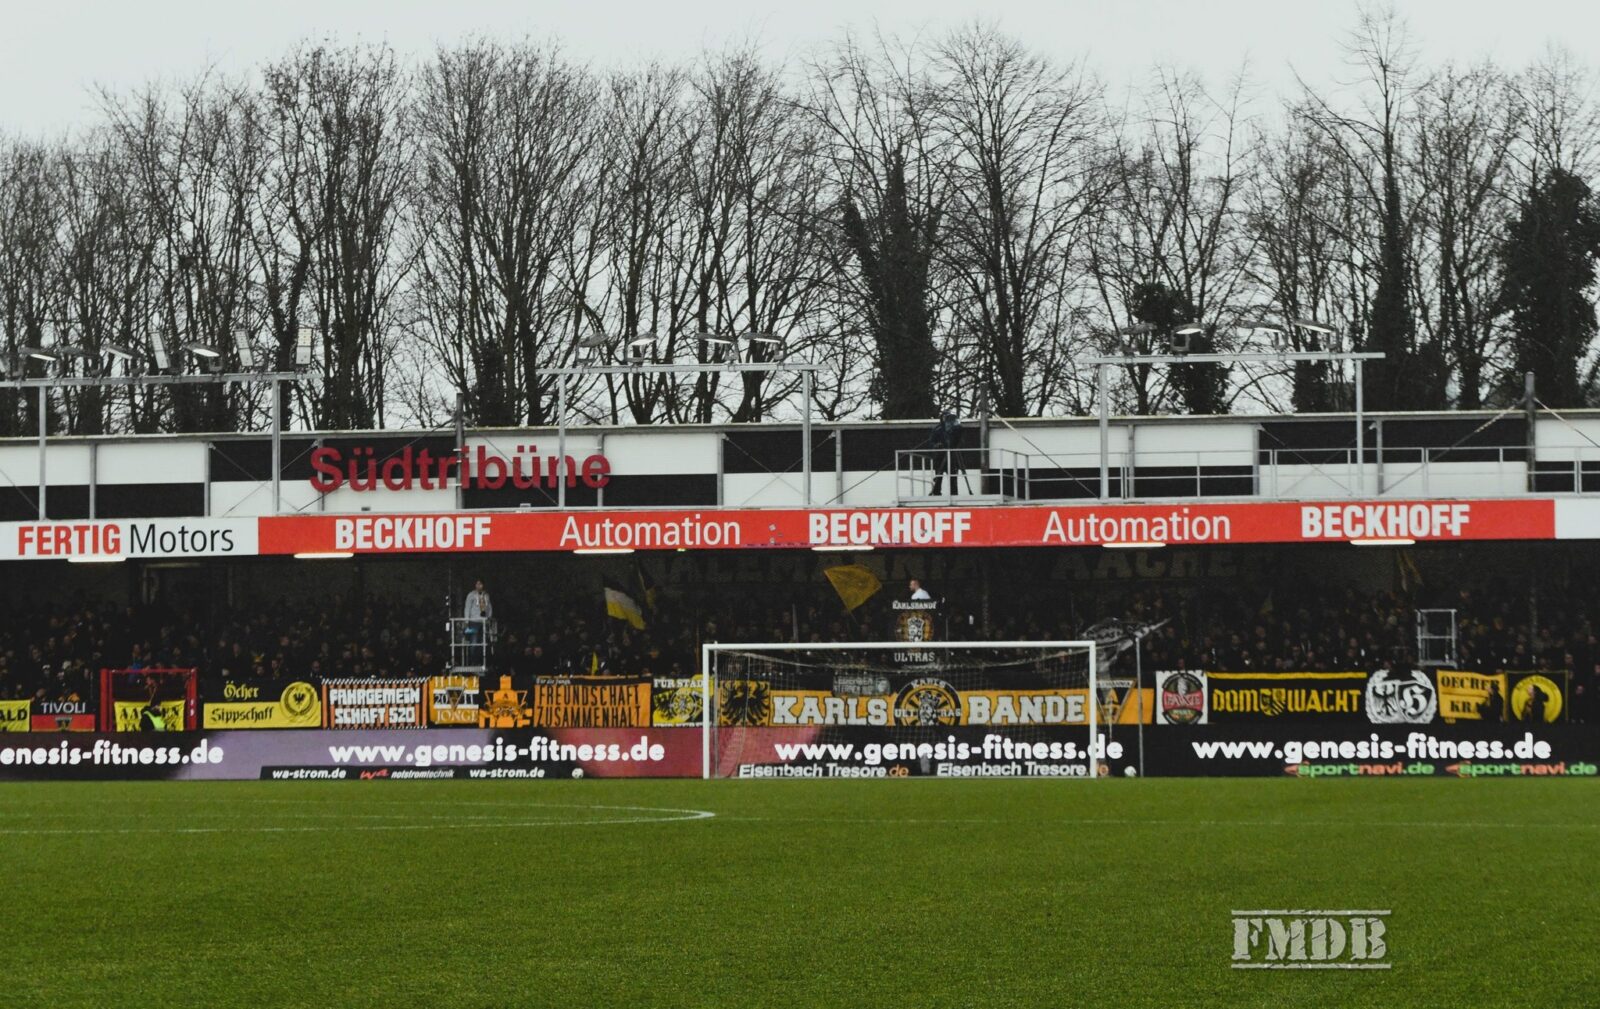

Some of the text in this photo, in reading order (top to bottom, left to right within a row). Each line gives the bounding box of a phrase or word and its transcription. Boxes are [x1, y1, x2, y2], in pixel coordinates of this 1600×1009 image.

[310, 445, 611, 492] Südtribüne
[335, 516, 491, 549] BECKHOFF
[560, 514, 741, 547] Automation
[809, 512, 971, 544] BECKHOFF
[1042, 508, 1231, 543] Automation
[1301, 504, 1471, 538] BECKHOFF
[18, 523, 234, 556] FERTIG Motors
[894, 652, 936, 663] ULTRAS
[41, 702, 86, 714] TIVOLI
[539, 684, 639, 706] FREUNDSCHAFT
[772, 695, 1086, 725] KARLS BANDE
[335, 706, 416, 724] SCHAFT 520
[537, 705, 641, 727] ZUSAMMENHALT
[328, 736, 665, 766] www.genesis-fitness.de
[775, 733, 1123, 765] www.genesis-fitness.de
[1192, 732, 1551, 764] www.genesis-fitness.de
[272, 767, 346, 779] wa-strom.de
[469, 767, 545, 778] wa-strom.de
[739, 763, 823, 777] Eisenbach
[937, 761, 1022, 776] Eisenbach
[1297, 761, 1435, 777] sportnavi.de
[1459, 761, 1597, 777] sportnavi.de
